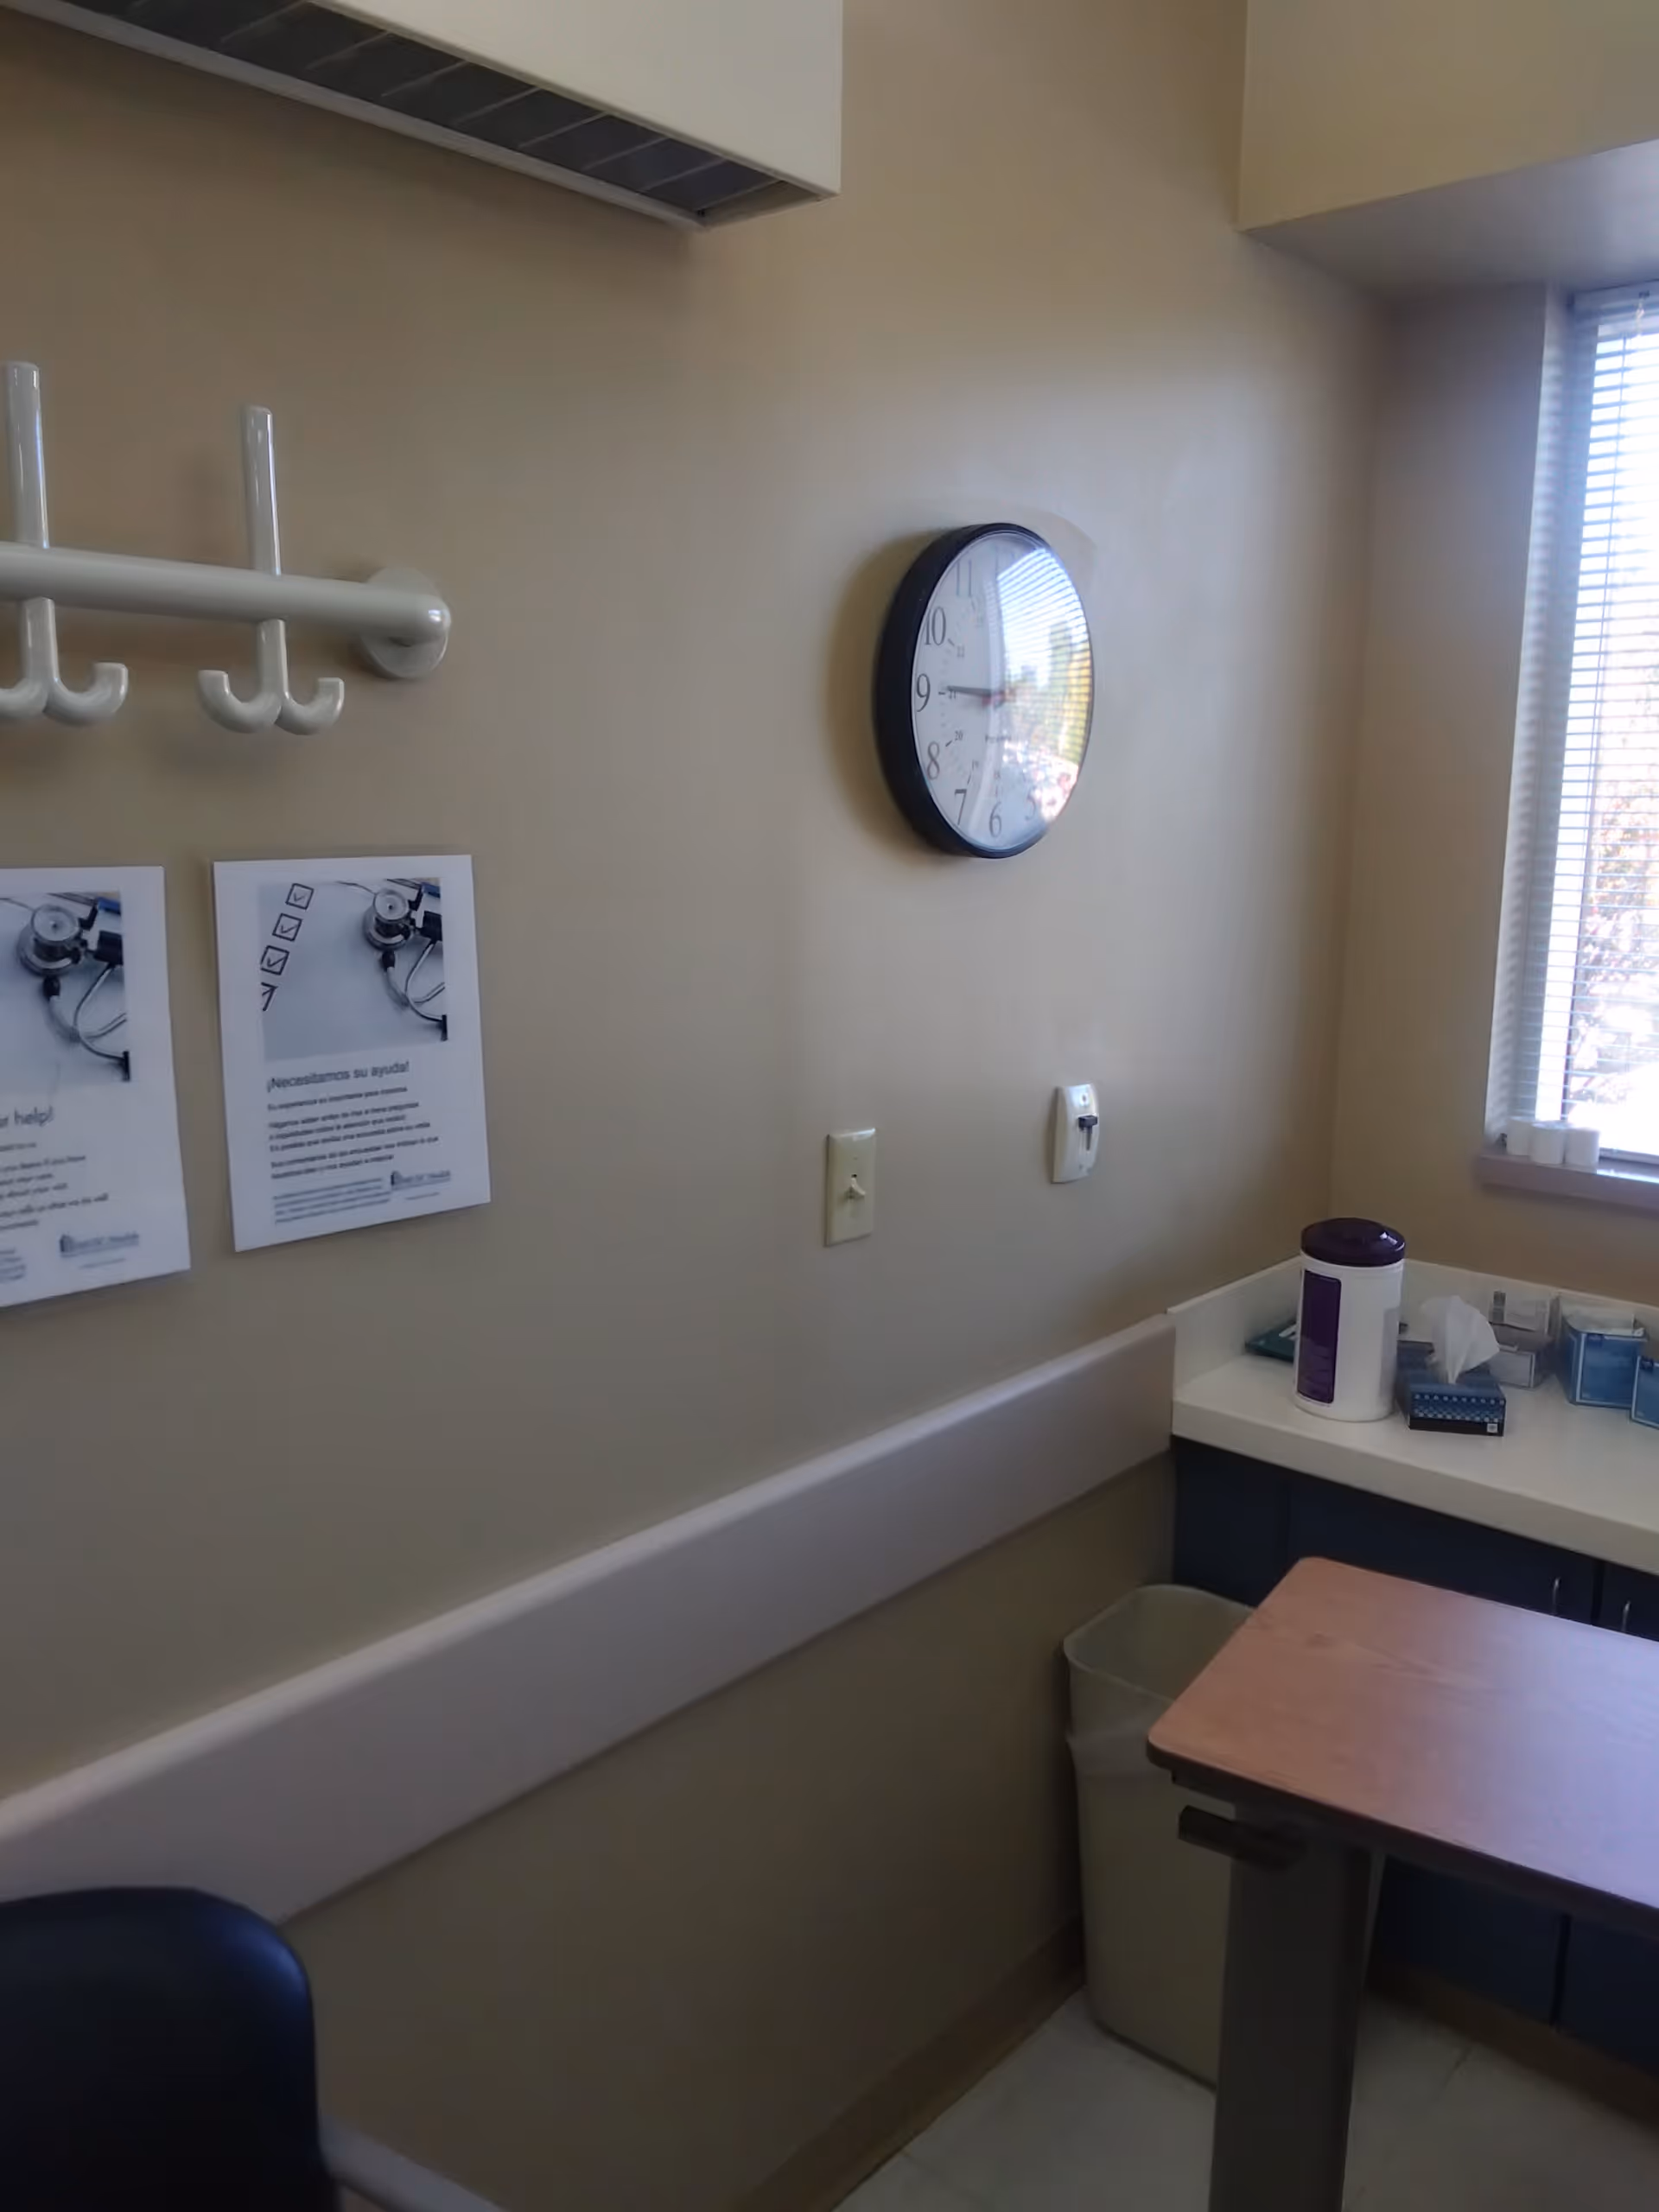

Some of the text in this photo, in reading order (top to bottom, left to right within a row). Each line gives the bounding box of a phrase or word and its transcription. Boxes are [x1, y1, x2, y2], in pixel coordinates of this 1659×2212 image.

[956, 560, 971, 597] 11
[924, 606, 946, 645] 10
[916, 673, 931, 712] 9
[926, 741, 940, 780] 8
[954, 789, 967, 826] 7
[989, 801, 1001, 838] 6
[352, 1067, 367, 1078] su
[371, 1060, 408, 1078] ayuda!
